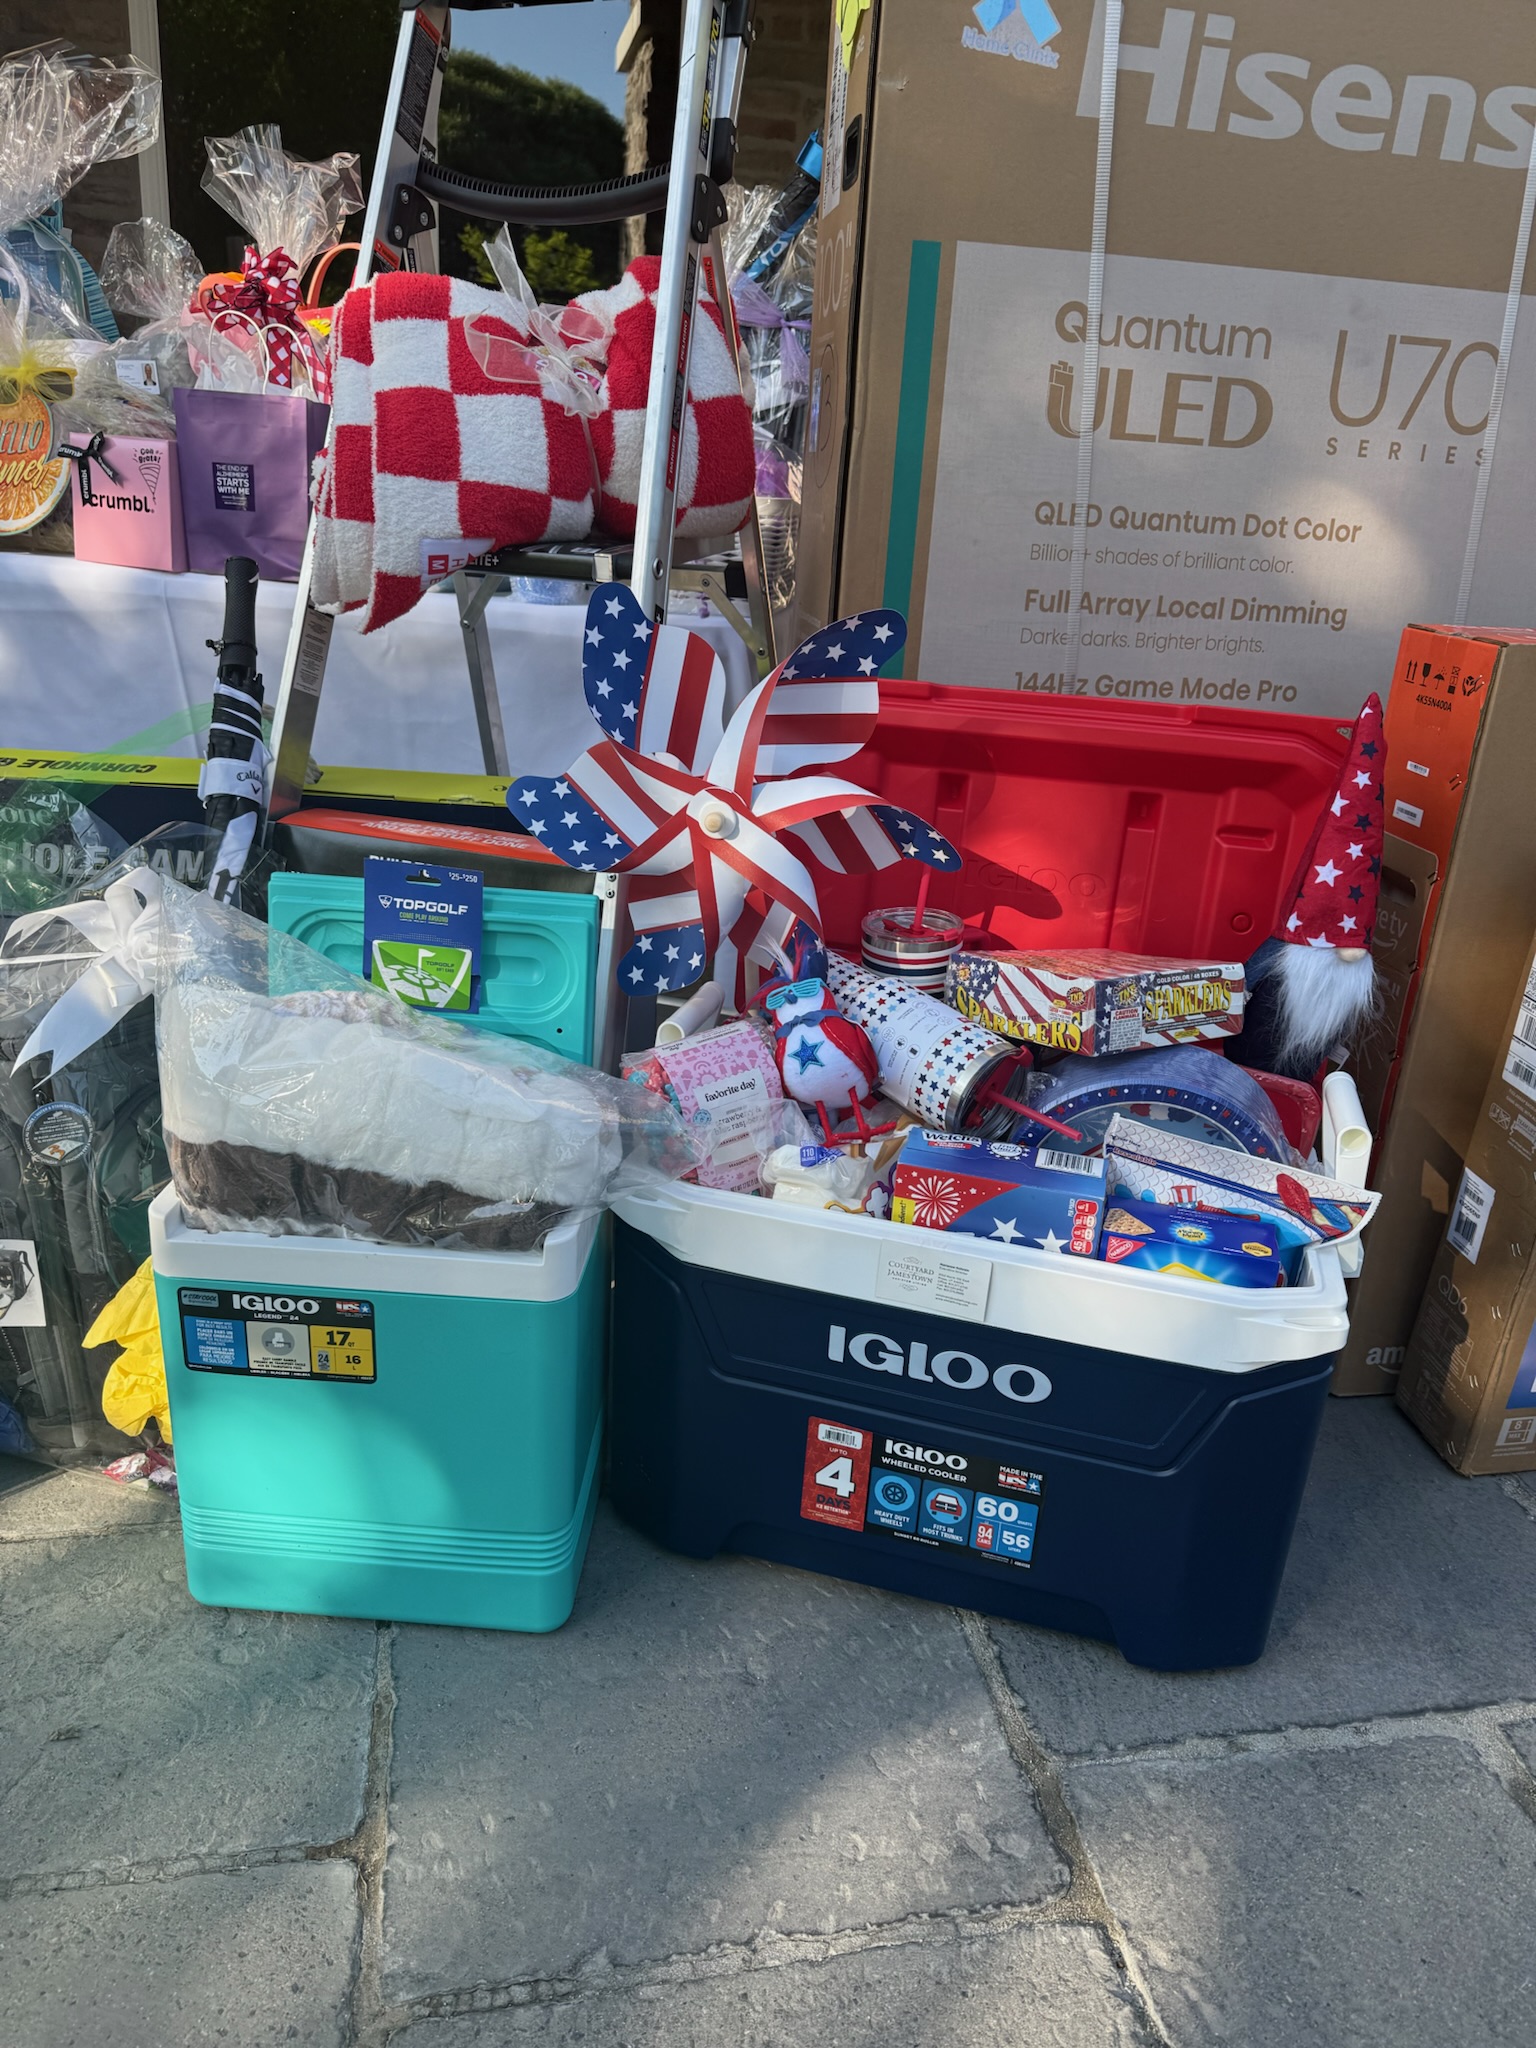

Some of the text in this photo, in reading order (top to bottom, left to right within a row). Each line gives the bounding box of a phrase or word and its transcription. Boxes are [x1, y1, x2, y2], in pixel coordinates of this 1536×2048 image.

[1075, 1, 1536, 170] Hisens
[1055, 301, 1271, 360] Quantum
[0, 420, 43, 454] ELLO
[1326, 437, 1485, 467] SERIES
[81, 469, 90, 499] crumbl
[216, 477, 250, 487] STARTS
[217, 486, 250, 495] WITH ME
[90, 494, 150, 513] crumbl
[1109, 505, 1237, 537] Quantum
[1243, 514, 1289, 539] Dot
[1294, 517, 1363, 543] Color
[1095, 547, 1159, 568] shades
[1162, 549, 1182, 569] of
[1183, 551, 1246, 572] brilliant
[1249, 556, 1295, 575] color.
[1024, 589, 1347, 632] Full Array Local Dimming
[1081, 629, 1131, 648] darks.
[1136, 633, 1202, 654] Brighter
[1205, 635, 1265, 656] brights.
[1015, 671, 1298, 703] 144Hz Game Mode Pro
[18, 758, 158, 774] CORNHOLE
[0, 804, 53, 827] one
[482, 837, 531, 849] DONE
[393, 897, 469, 915] TOPGOLF
[399, 911, 414, 919] COME
[426, 960, 455, 968] TOPGOLF
[1157, 975, 1172, 984] GOLD
[1172, 973, 1190, 982] COLOR
[1201, 970, 1219, 978] BOXES
[1069, 992, 1084, 1001] TNT
[1145, 981, 1232, 1021] SPARKLERS
[956, 986, 1084, 1052] SPARKLERS
[704, 1078, 756, 1103] favorite day
[802, 1148, 815, 1157] 110
[888, 1260, 934, 1275] COURTYARD
[887, 1269, 933, 1284] JAMESTOWN
[1438, 1275, 1468, 1315] QD6
[232, 1293, 320, 1315] IGLOO
[254, 1312, 282, 1320] LEGEND
[326, 1331, 350, 1347] 17
[203, 1357, 233, 1365] RESULTADOS
[318, 1353, 329, 1364] 24
[345, 1355, 362, 1365] 16
[827, 1324, 1052, 1404] IGLOO
[1514, 1420, 1523, 1430] 8
[839, 1448, 848, 1456] TO
[884, 1438, 968, 1471] IGLOO
[815, 1456, 856, 1499] 4
[881, 1456, 967, 1483] WHEELED COOLER
[999, 1465, 1020, 1475] MADE
[1029, 1472, 1043, 1481] THE
[816, 1493, 851, 1510] DAYS
[824, 1505, 849, 1515] RETENTION
[976, 1496, 1019, 1523] 60
[874, 1509, 910, 1523] HEAVY DUTY
[880, 1517, 903, 1528] WHEELS
[923, 1526, 963, 1543] MOST TRUNKS
[933, 1523, 947, 1532] FITS
[977, 1525, 993, 1540] 94
[976, 1537, 992, 1547] CANS
[1002, 1530, 1031, 1550] 56
